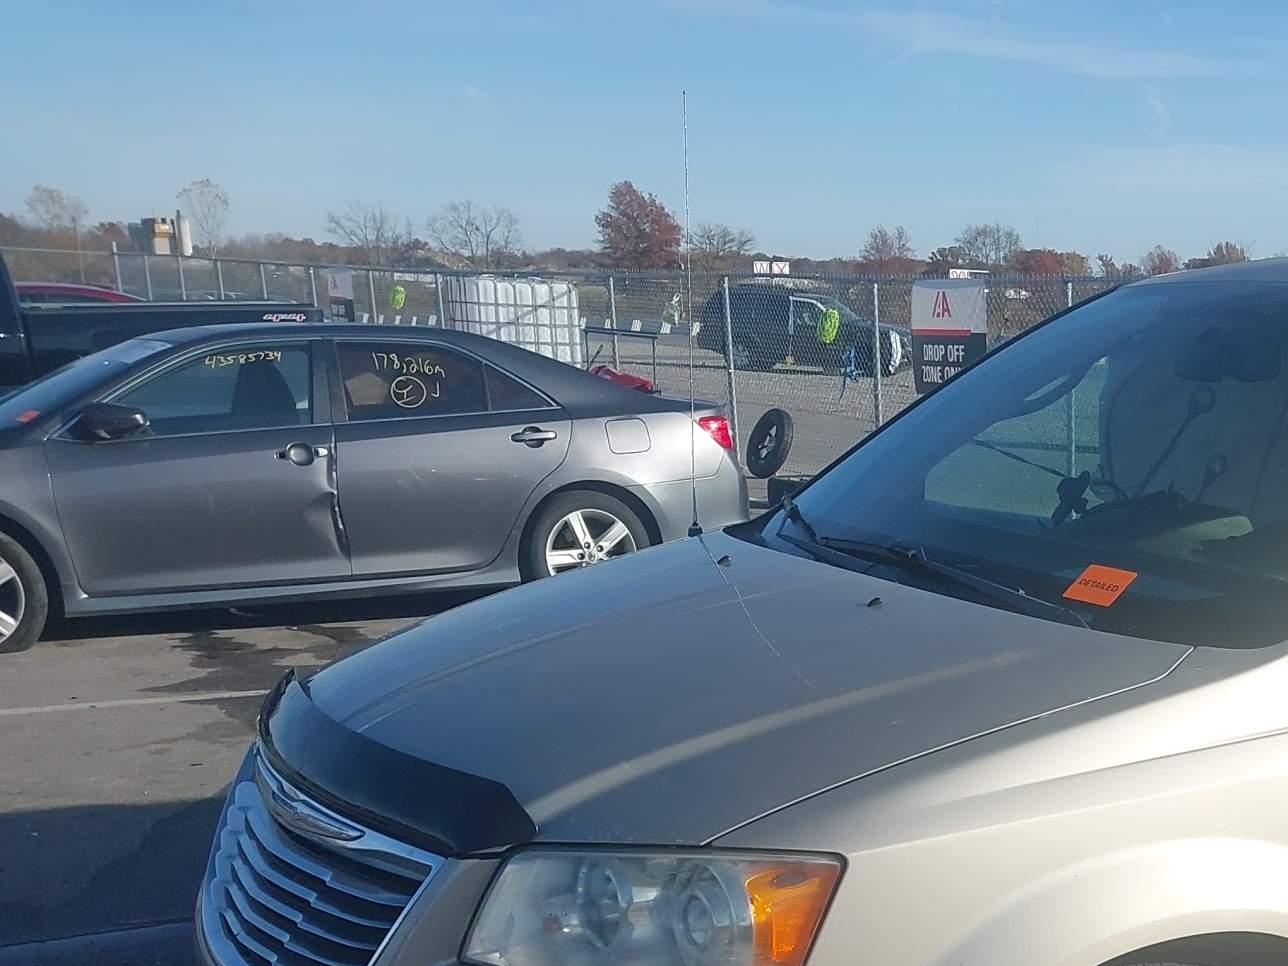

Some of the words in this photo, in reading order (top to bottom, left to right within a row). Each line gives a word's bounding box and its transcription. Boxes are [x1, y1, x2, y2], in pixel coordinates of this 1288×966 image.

[204, 351, 282, 369] 43585734
[923, 344, 946, 362] DROP
[947, 345, 965, 363] OFF
[921, 364, 943, 384] ZONE
[1078, 578, 1120, 593] DETAILED
